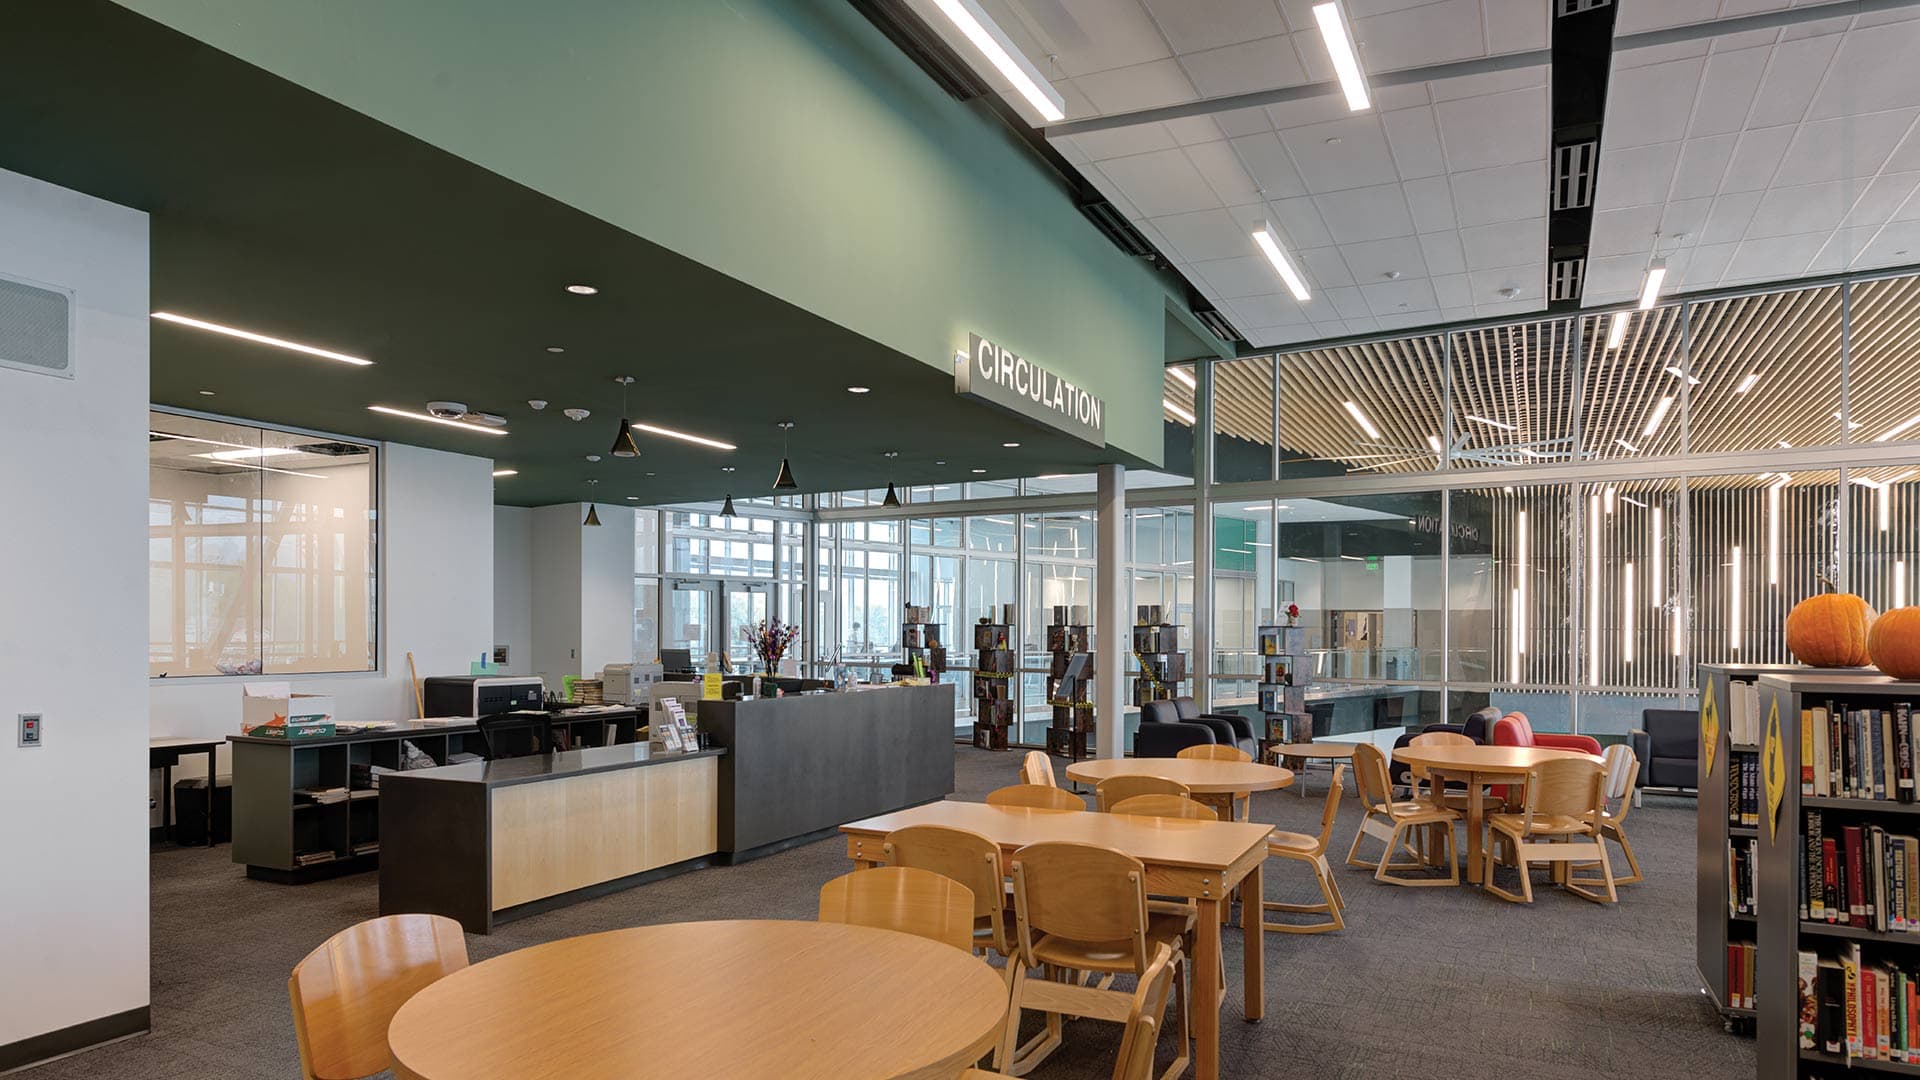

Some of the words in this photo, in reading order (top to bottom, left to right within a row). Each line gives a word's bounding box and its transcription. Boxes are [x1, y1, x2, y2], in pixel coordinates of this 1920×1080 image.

[978, 338, 1101, 430] CIRCULATION
[1896, 709, 1908, 735] KAHN
[1847, 987, 1857, 1033] PHILOSOPHY
